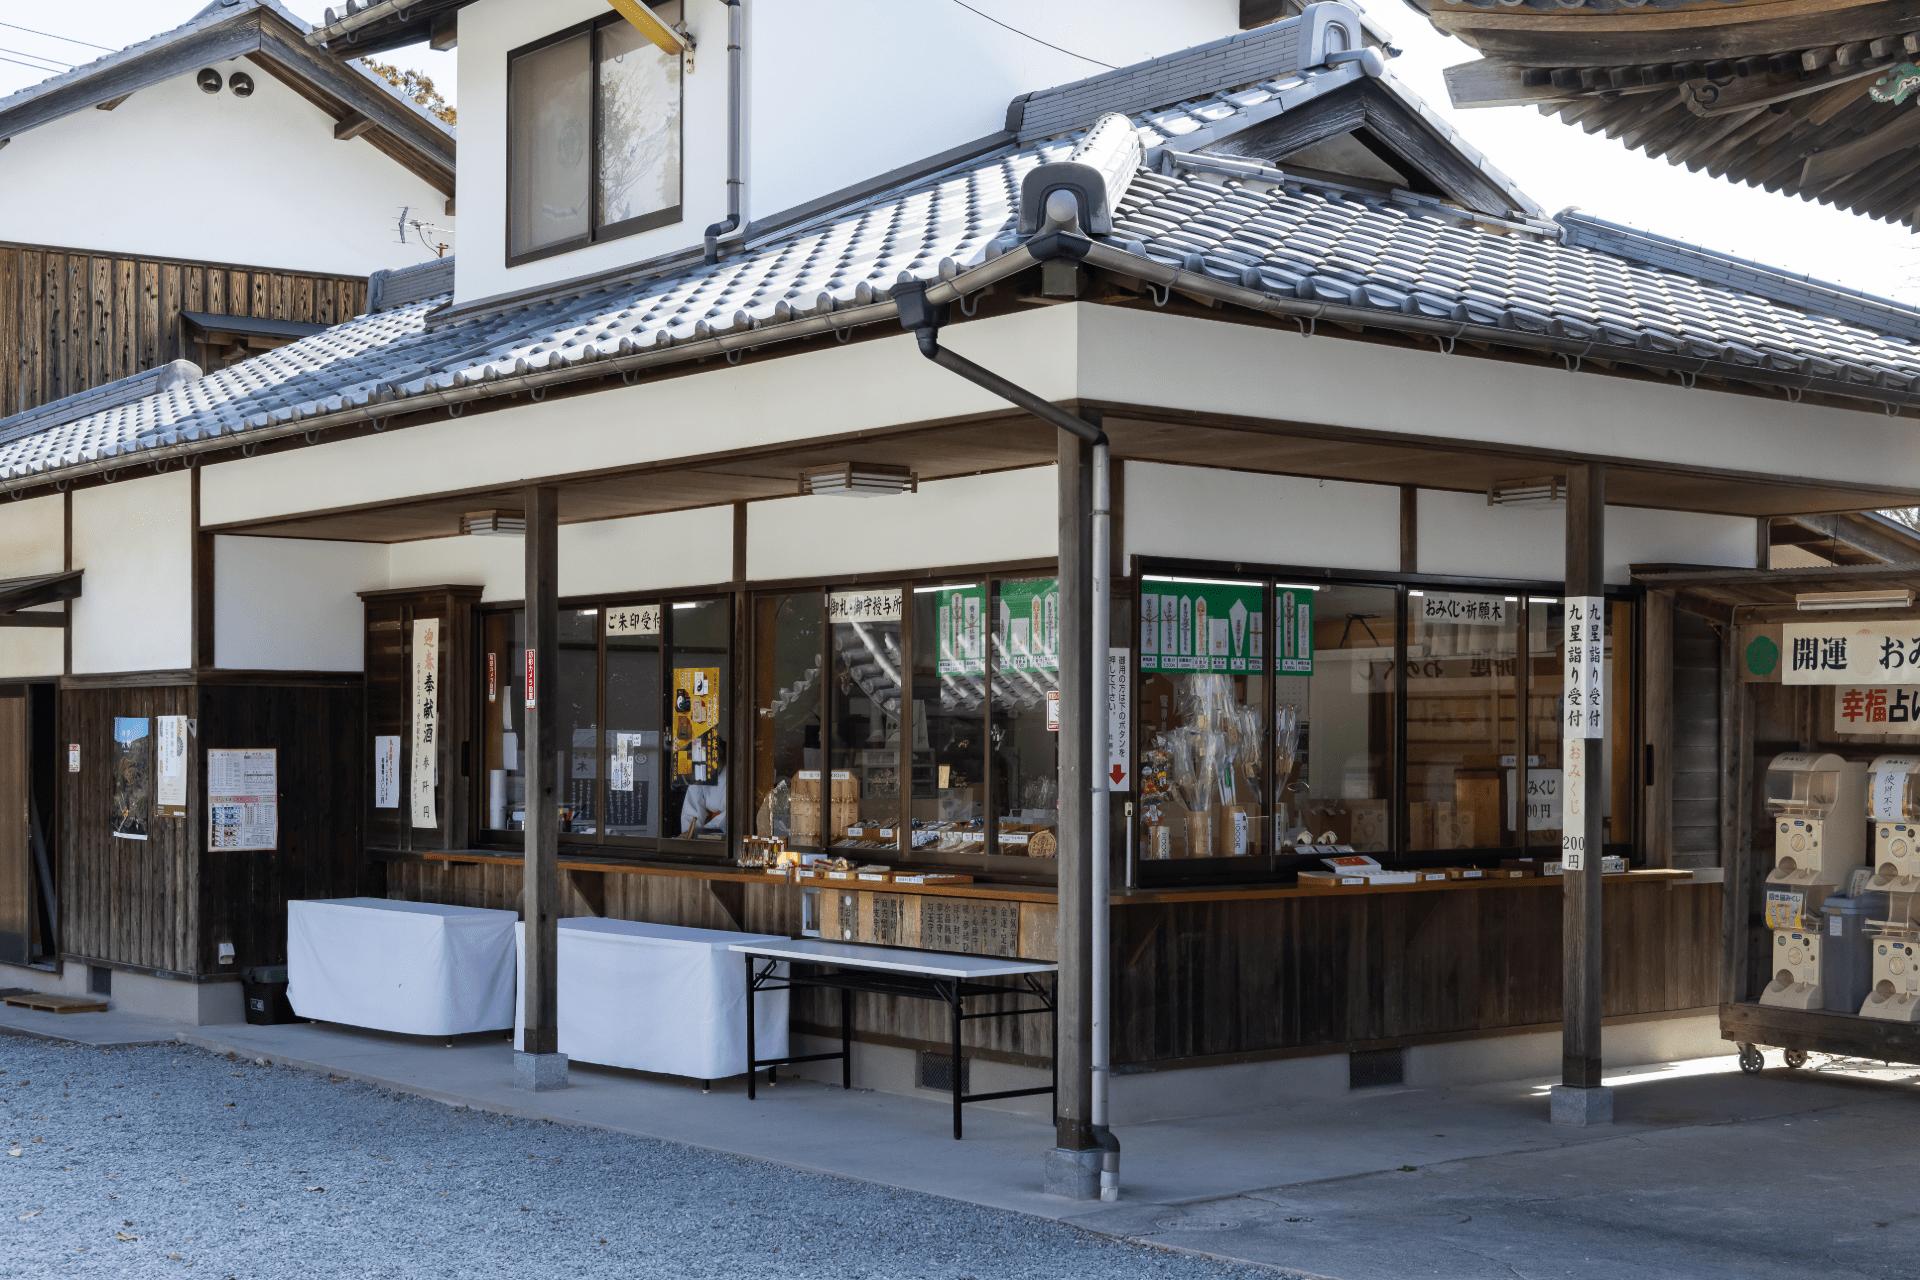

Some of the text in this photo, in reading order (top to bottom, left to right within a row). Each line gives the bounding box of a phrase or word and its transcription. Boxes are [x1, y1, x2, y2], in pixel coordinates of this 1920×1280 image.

[1426, 598, 1502, 621] おみくじ・祈願木
[608, 611, 660, 631] ご朱印受付
[1792, 636, 1847, 671] 開運
[1568, 604, 1582, 727] 九星詣り受付
[1589, 604, 1601, 727] 九星詣り受付
[1528, 780, 1556, 796] みくじ
[1567, 745, 1581, 815] おみくじ
[1527, 804, 1551, 818] 00円
[1563, 836, 1585, 850] 200
[1568, 854, 1579, 869] 円
